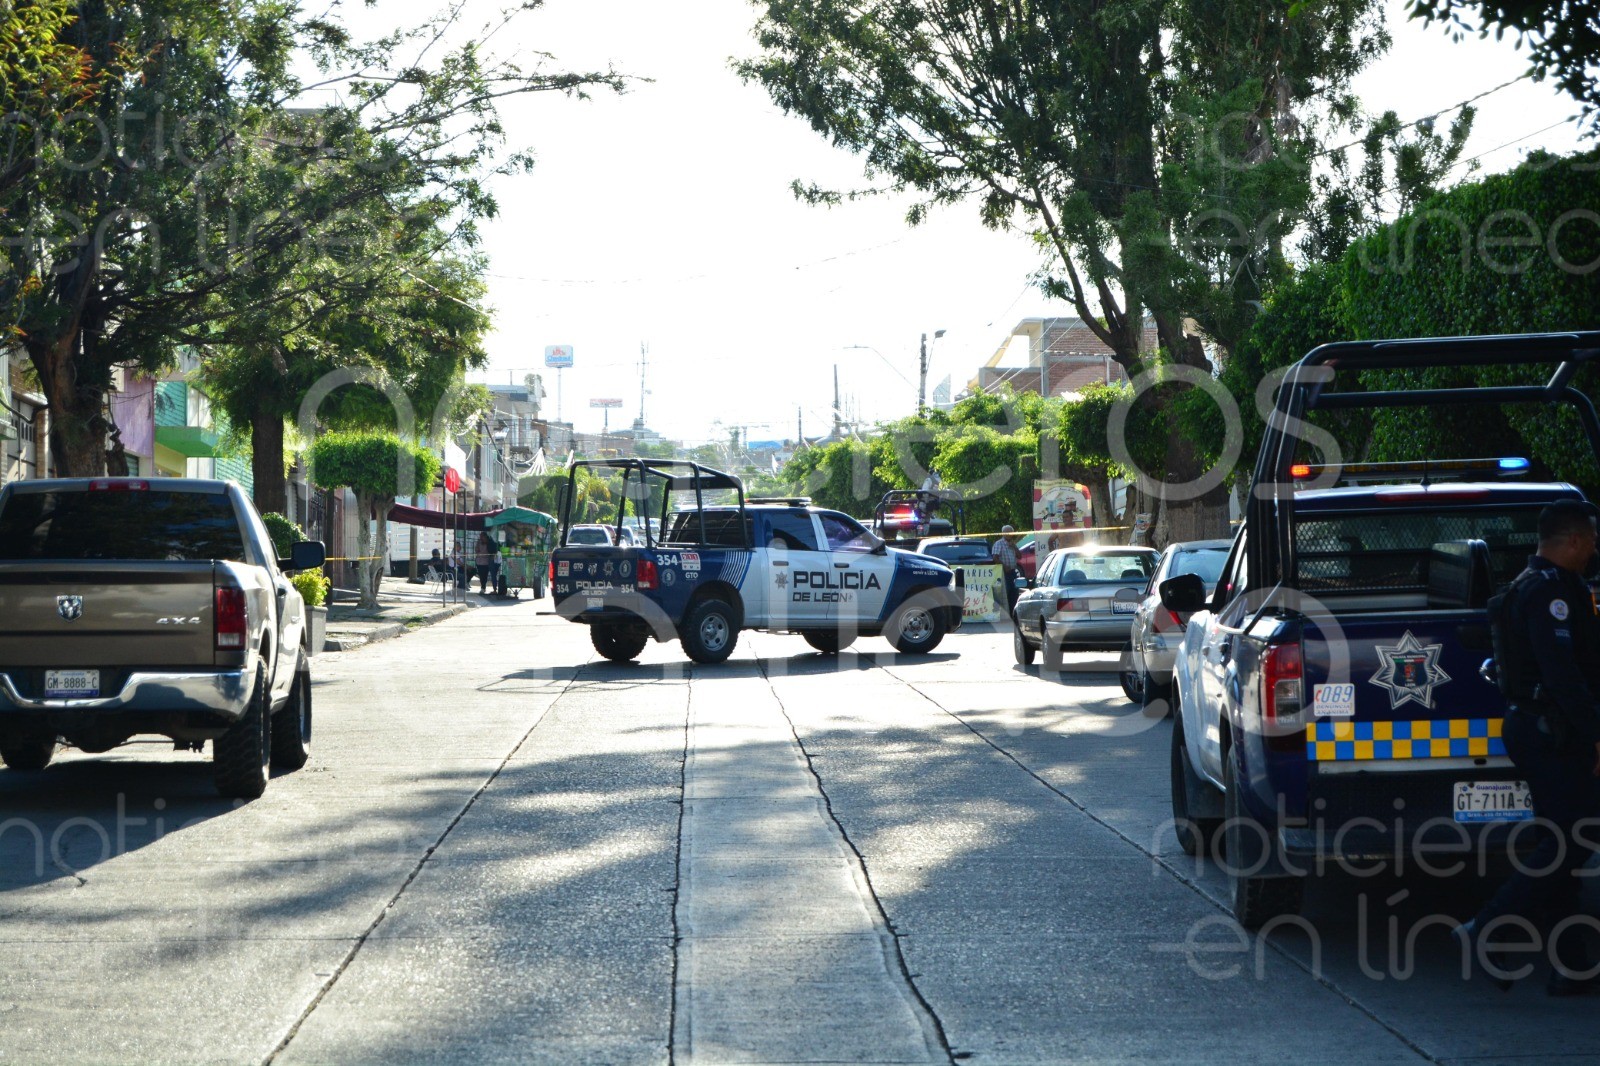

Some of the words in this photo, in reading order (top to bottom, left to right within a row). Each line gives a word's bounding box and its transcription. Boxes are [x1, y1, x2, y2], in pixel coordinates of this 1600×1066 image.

[657, 555, 679, 566] 354
[964, 568, 993, 578] ARTES
[793, 569, 881, 590] POLICÍA
[557, 584, 569, 593] 354
[621, 584, 634, 593] 354
[965, 583, 989, 592] UEVES
[793, 592, 810, 602] DE
[47, 677, 97, 689] GM-8888-C
[1321, 685, 1354, 703] 089
[1457, 792, 1532, 811] GT-711A-6
